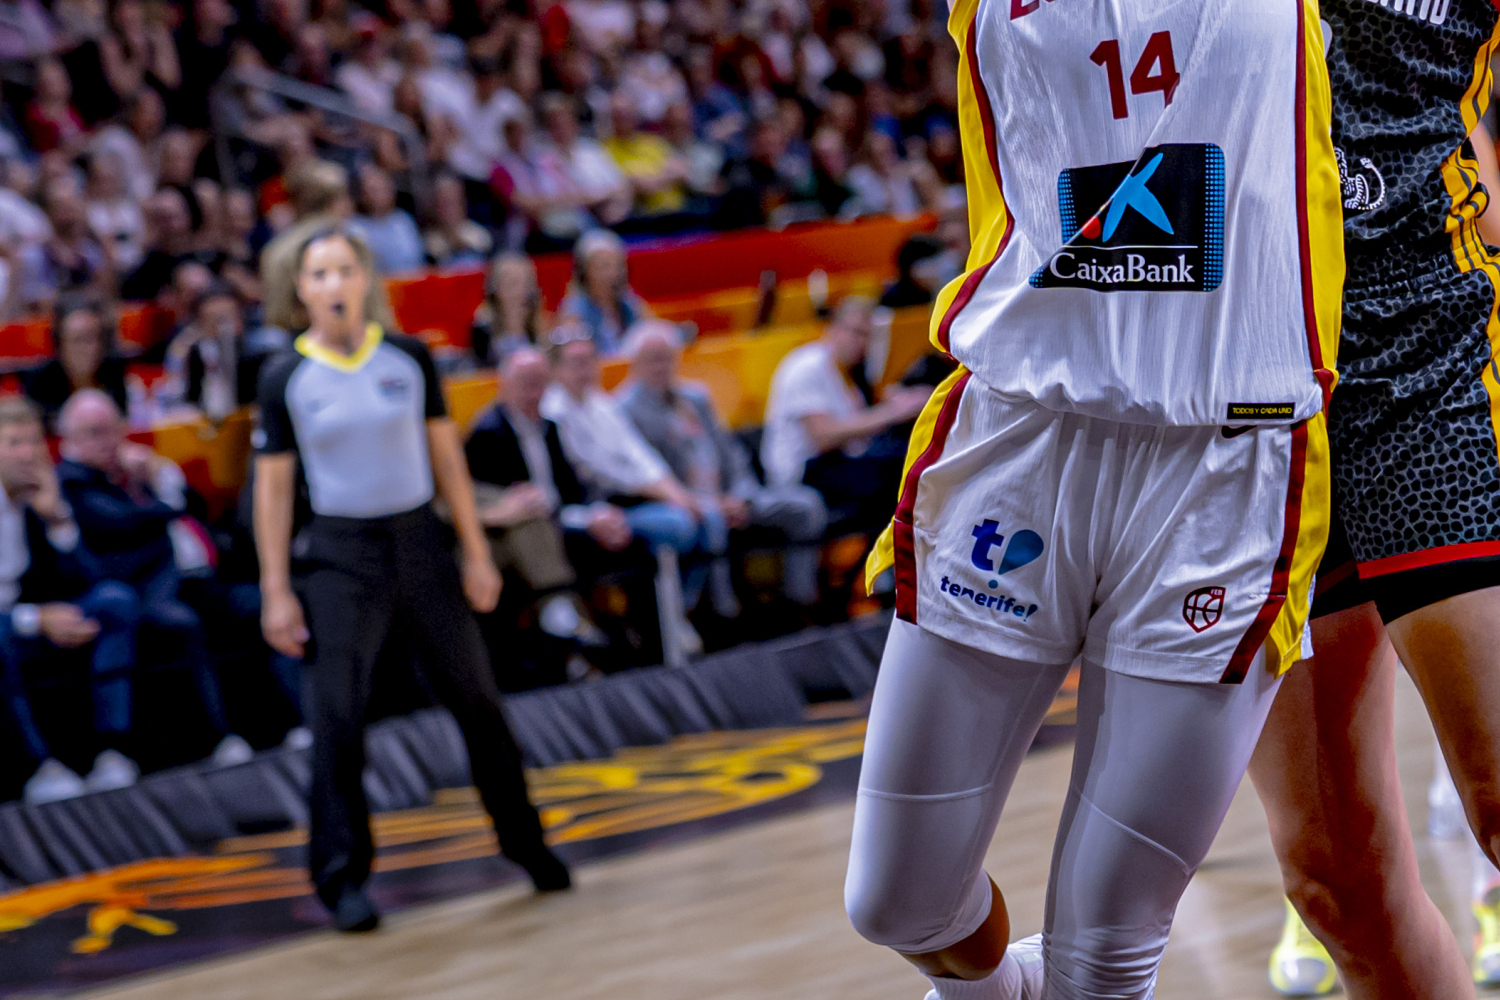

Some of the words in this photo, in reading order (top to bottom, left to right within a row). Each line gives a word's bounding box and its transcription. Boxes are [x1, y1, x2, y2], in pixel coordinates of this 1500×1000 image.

[1090, 30, 1180, 120] 14
[1050, 252, 1196, 284] CaixaBank
[1232, 407, 1254, 415] TODOS
[1254, 407, 1260, 415] Y
[1260, 407, 1278, 415] CADA
[1278, 407, 1293, 415] UNO
[1210, 588, 1223, 596] FEB
